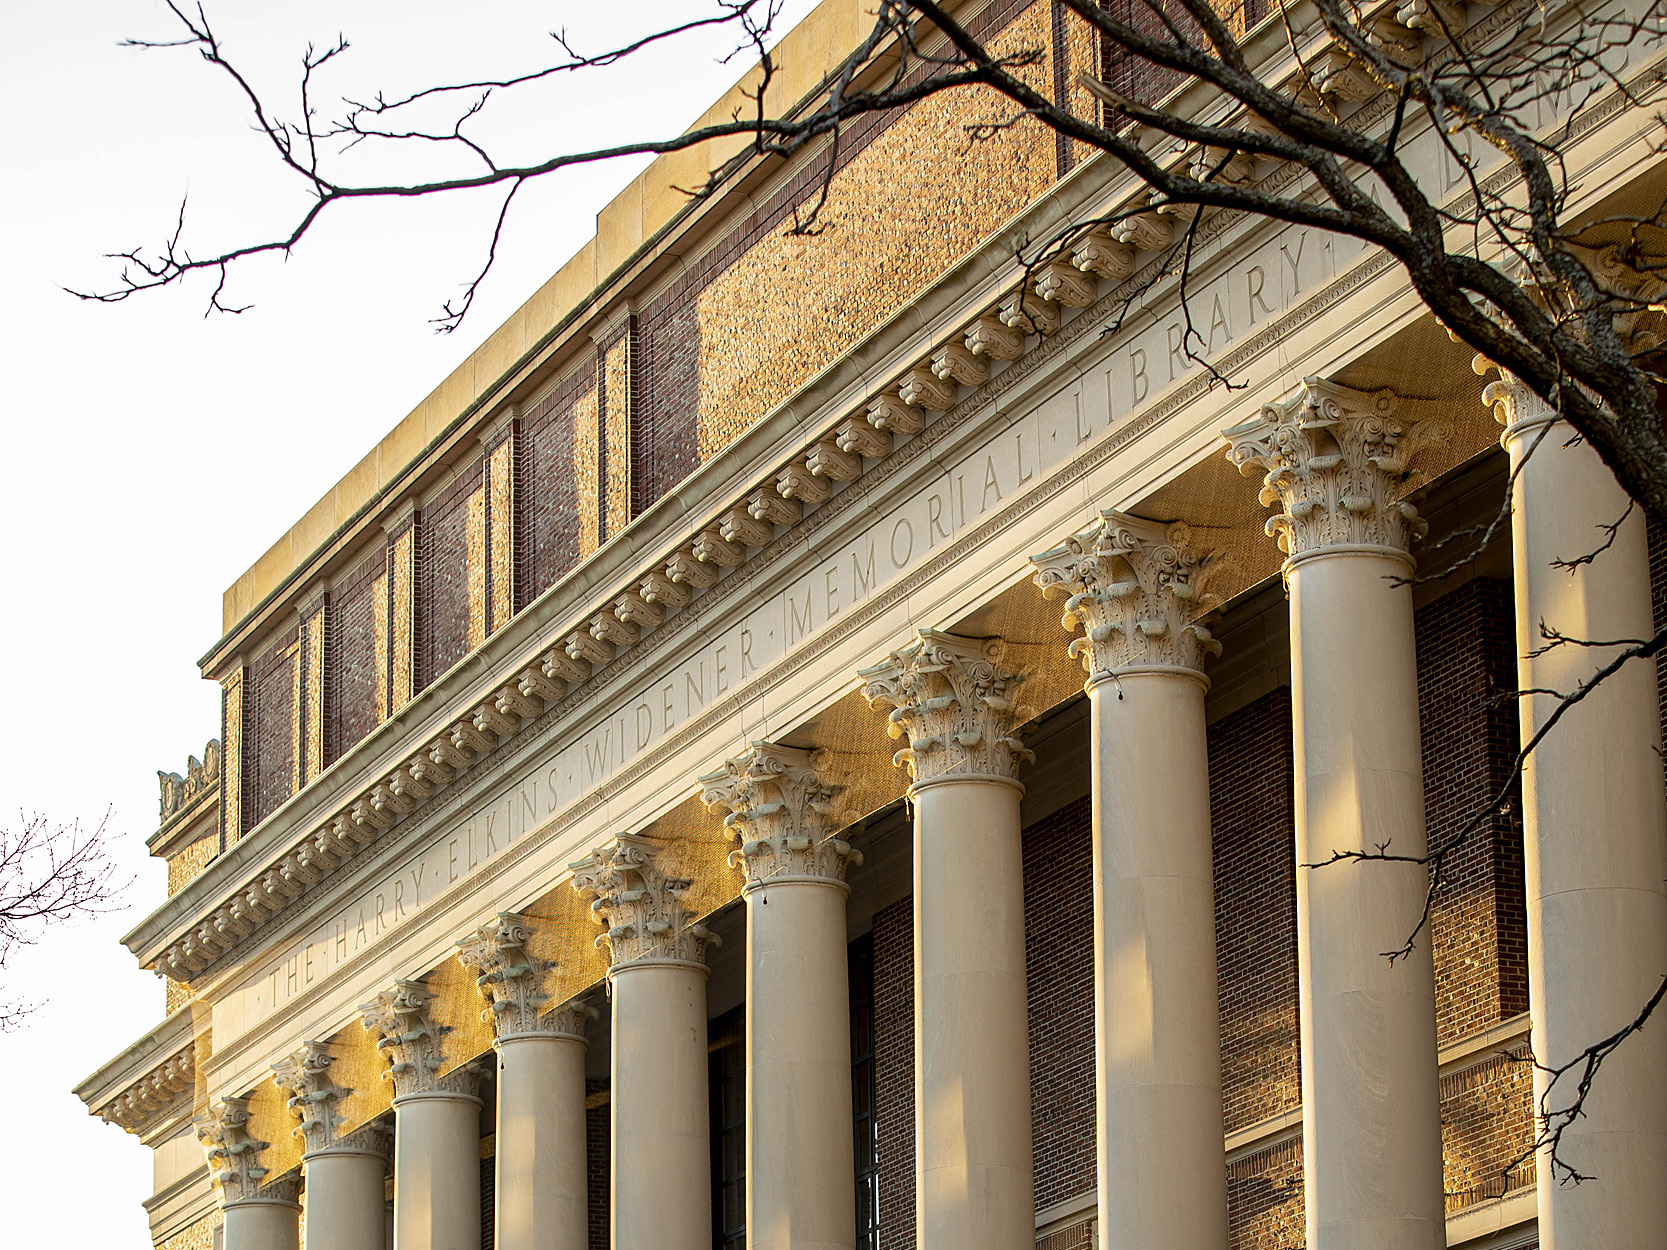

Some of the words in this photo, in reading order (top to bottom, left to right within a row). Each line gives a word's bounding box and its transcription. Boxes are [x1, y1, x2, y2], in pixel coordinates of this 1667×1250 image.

[269, 944, 314, 1007] THE
[334, 862, 426, 964] HARRY
[448, 767, 560, 884] ELKINS
[584, 629, 759, 784] WIDENER
[789, 433, 1034, 645] MEMORIAL
[1073, 230, 1308, 447] LIBRARY
